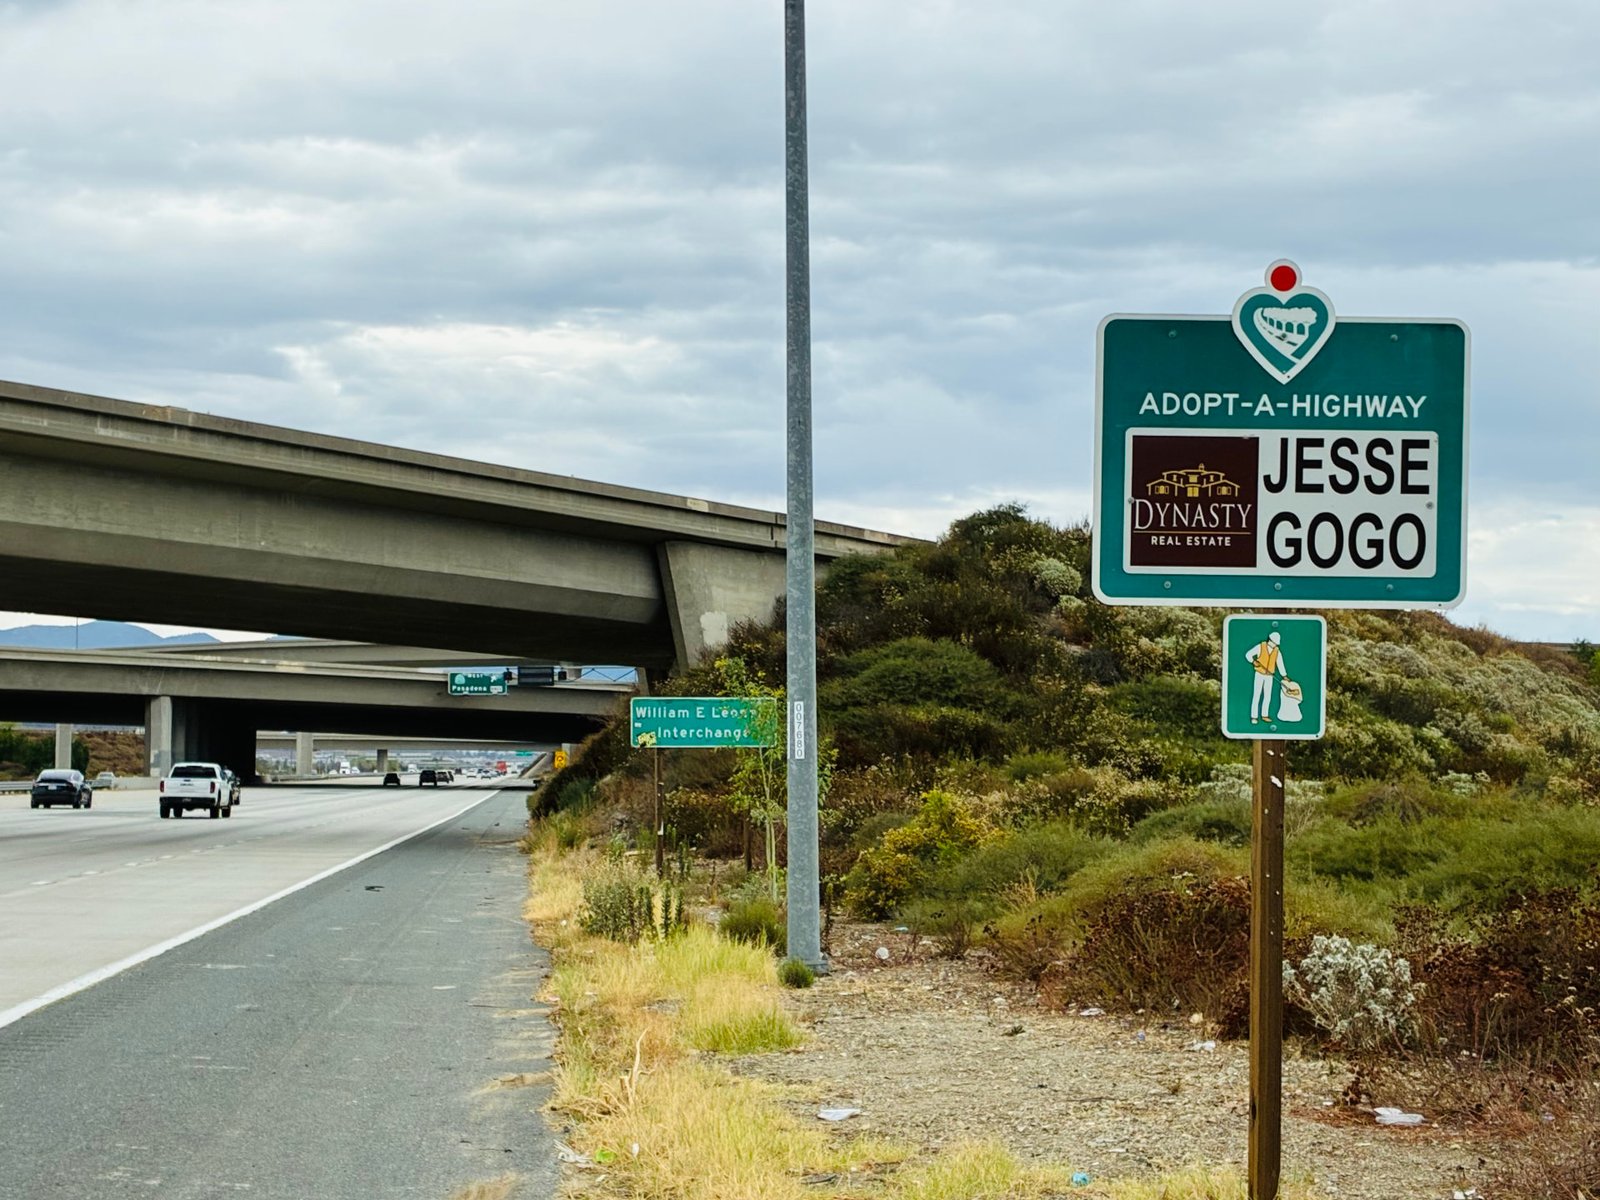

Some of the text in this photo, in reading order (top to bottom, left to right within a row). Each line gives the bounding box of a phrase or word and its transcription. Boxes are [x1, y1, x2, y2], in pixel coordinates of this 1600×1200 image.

[1139, 392, 1427, 418] ADOPT-A-HIGHWAY
[1263, 437, 1430, 494] JESSE
[1134, 499, 1252, 530] DYNASTY
[1151, 535, 1232, 547] REAL ESTATE
[1266, 511, 1426, 569] GOGO
[635, 706, 690, 719] William
[696, 707, 705, 719] E
[657, 726, 750, 742] Interchange
